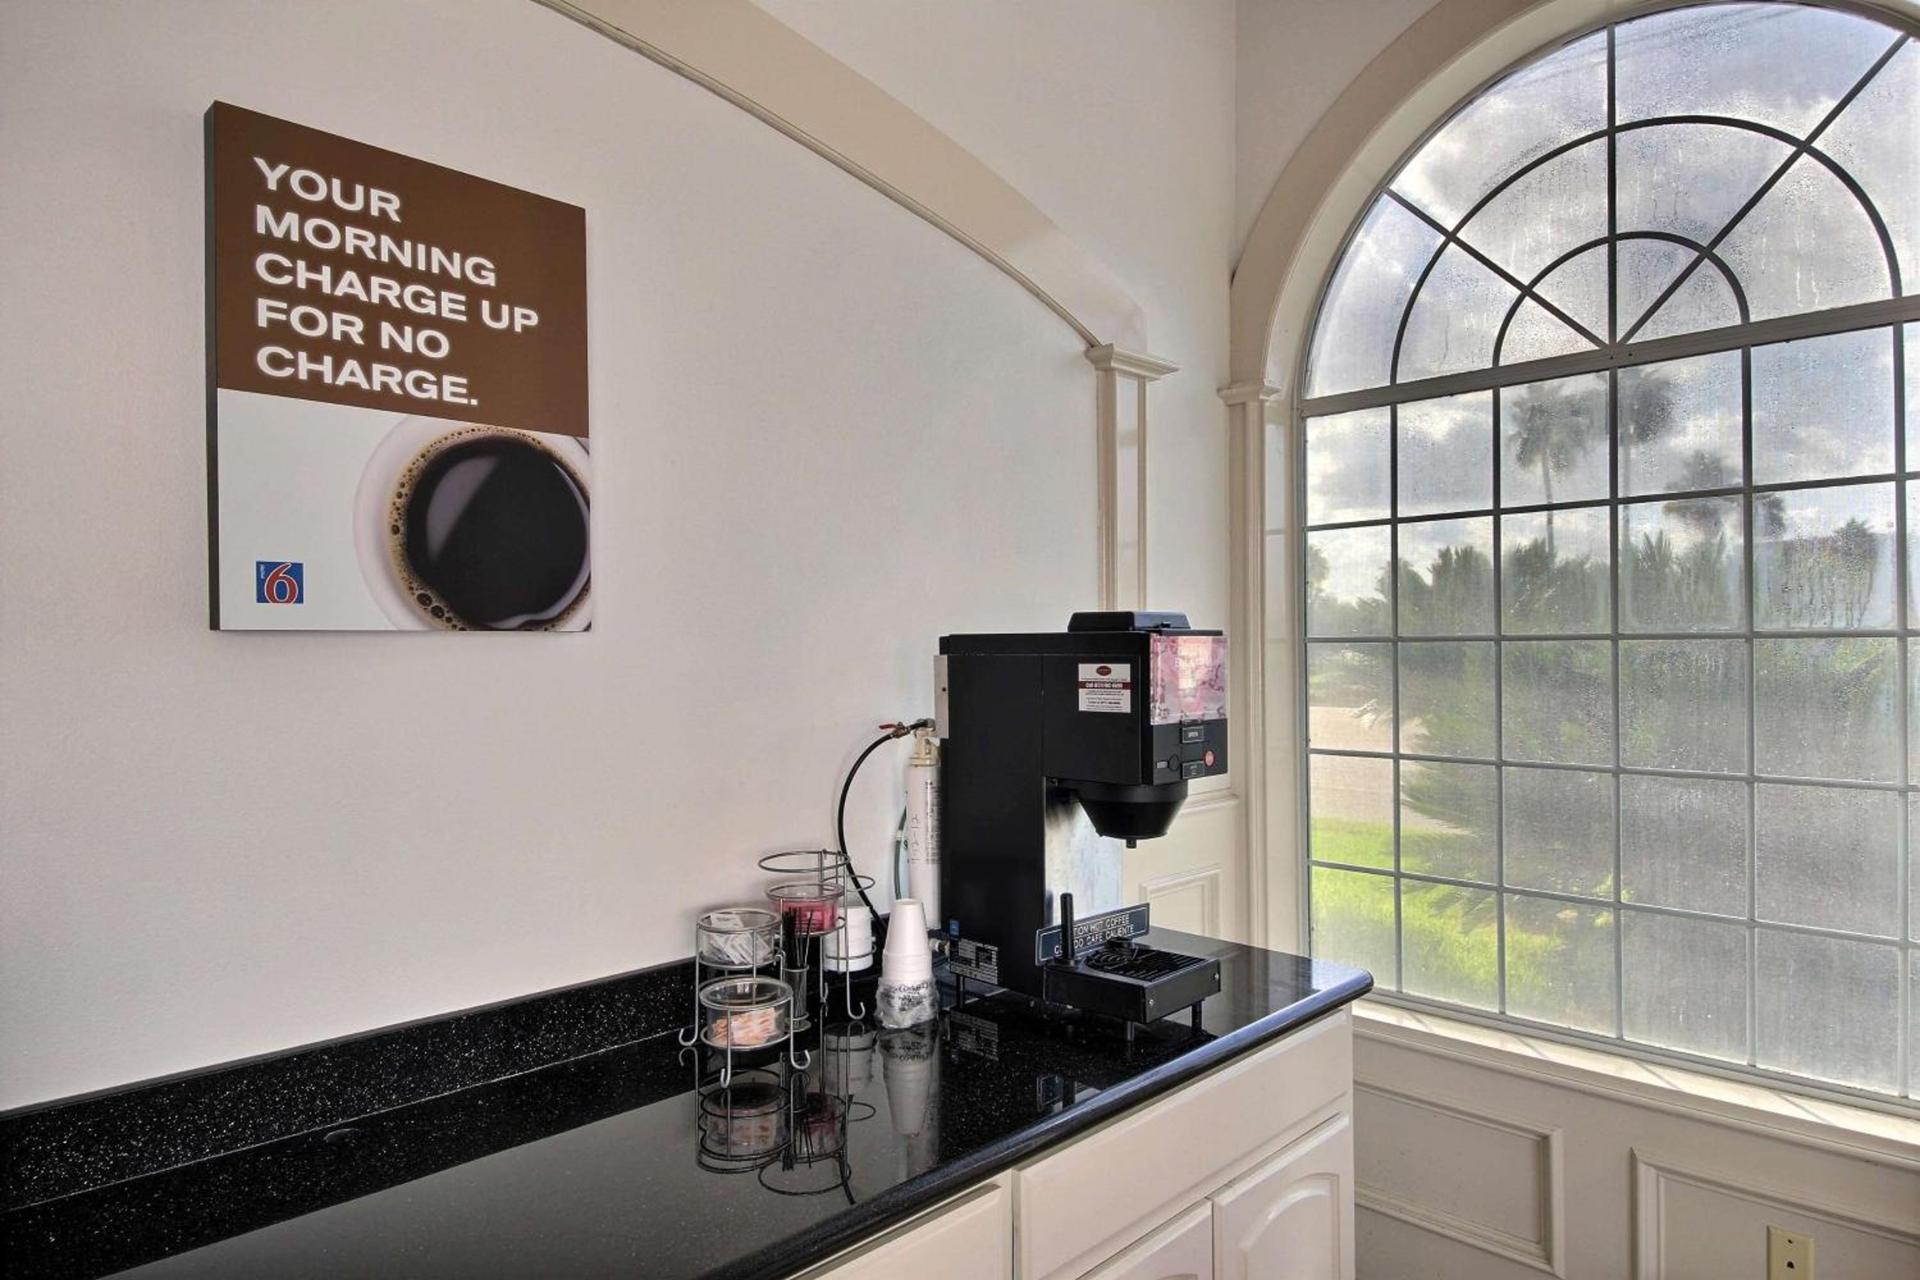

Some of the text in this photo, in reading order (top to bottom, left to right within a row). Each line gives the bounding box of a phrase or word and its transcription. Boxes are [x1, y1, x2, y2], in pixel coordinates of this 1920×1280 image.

[254, 156, 402, 223] YOUR
[256, 204, 496, 287] MORNING
[255, 252, 539, 334] CHARGE UP
[257, 297, 450, 359] FOR NO
[256, 345, 479, 406] CHARGE.
[264, 560, 299, 605] 6
